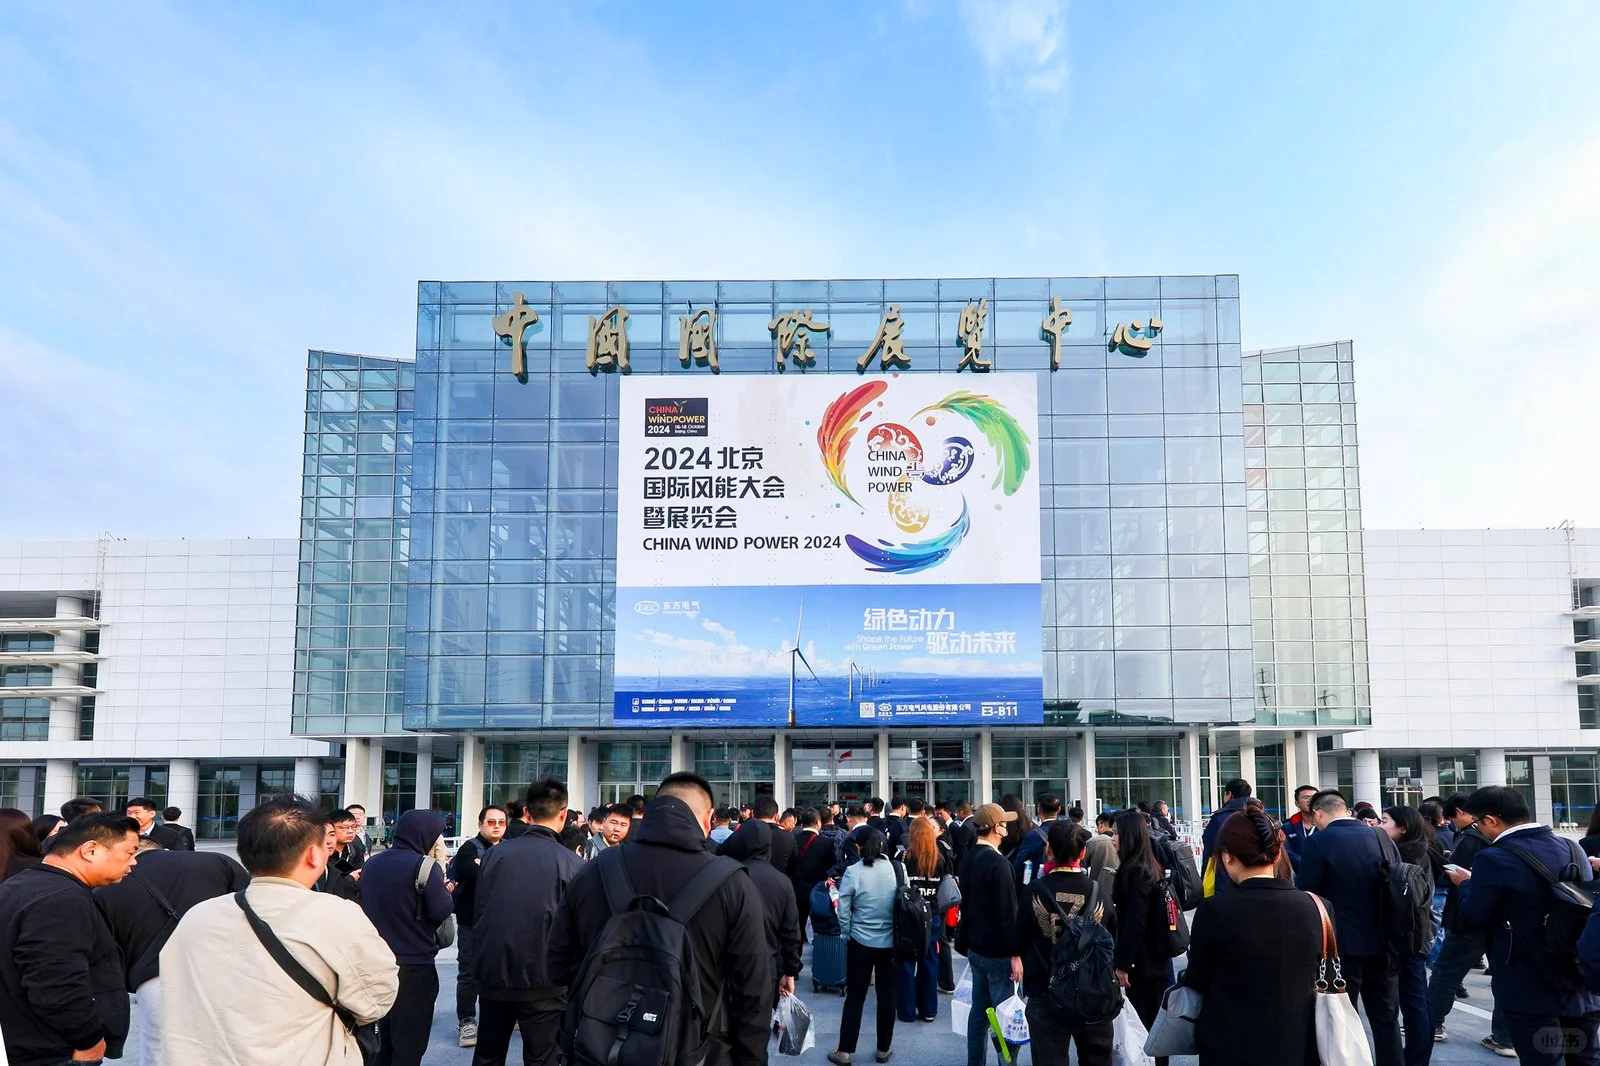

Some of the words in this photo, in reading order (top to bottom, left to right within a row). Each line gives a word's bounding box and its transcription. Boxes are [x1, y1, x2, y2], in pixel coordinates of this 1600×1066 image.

[648, 406, 678, 414] CHINA
[648, 415, 706, 424] WINDPOWER
[648, 425, 671, 434] 2024
[644, 447, 712, 470] 2024
[717, 446, 763, 470] 北京
[868, 450, 907, 461] CHINA
[868, 466, 903, 477] WIND
[643, 476, 785, 500] 国际风能大会
[868, 482, 913, 493] POWER
[643, 505, 737, 530] 暨展览会
[643, 538, 691, 550] CHINA
[695, 537, 738, 550] WIND
[744, 536, 799, 550] POWER
[804, 536, 842, 549] 2024
[662, 601, 700, 610] 东方电气
[863, 607, 955, 631] 绿色动力
[856, 635, 883, 645] Shape
[884, 635, 899, 644] the
[900, 635, 925, 644] Future
[926, 631, 1017, 655] 驱动未来
[863, 643, 888, 651] Green
[889, 643, 914, 651] Power
[981, 706, 1018, 717] E3-B11
